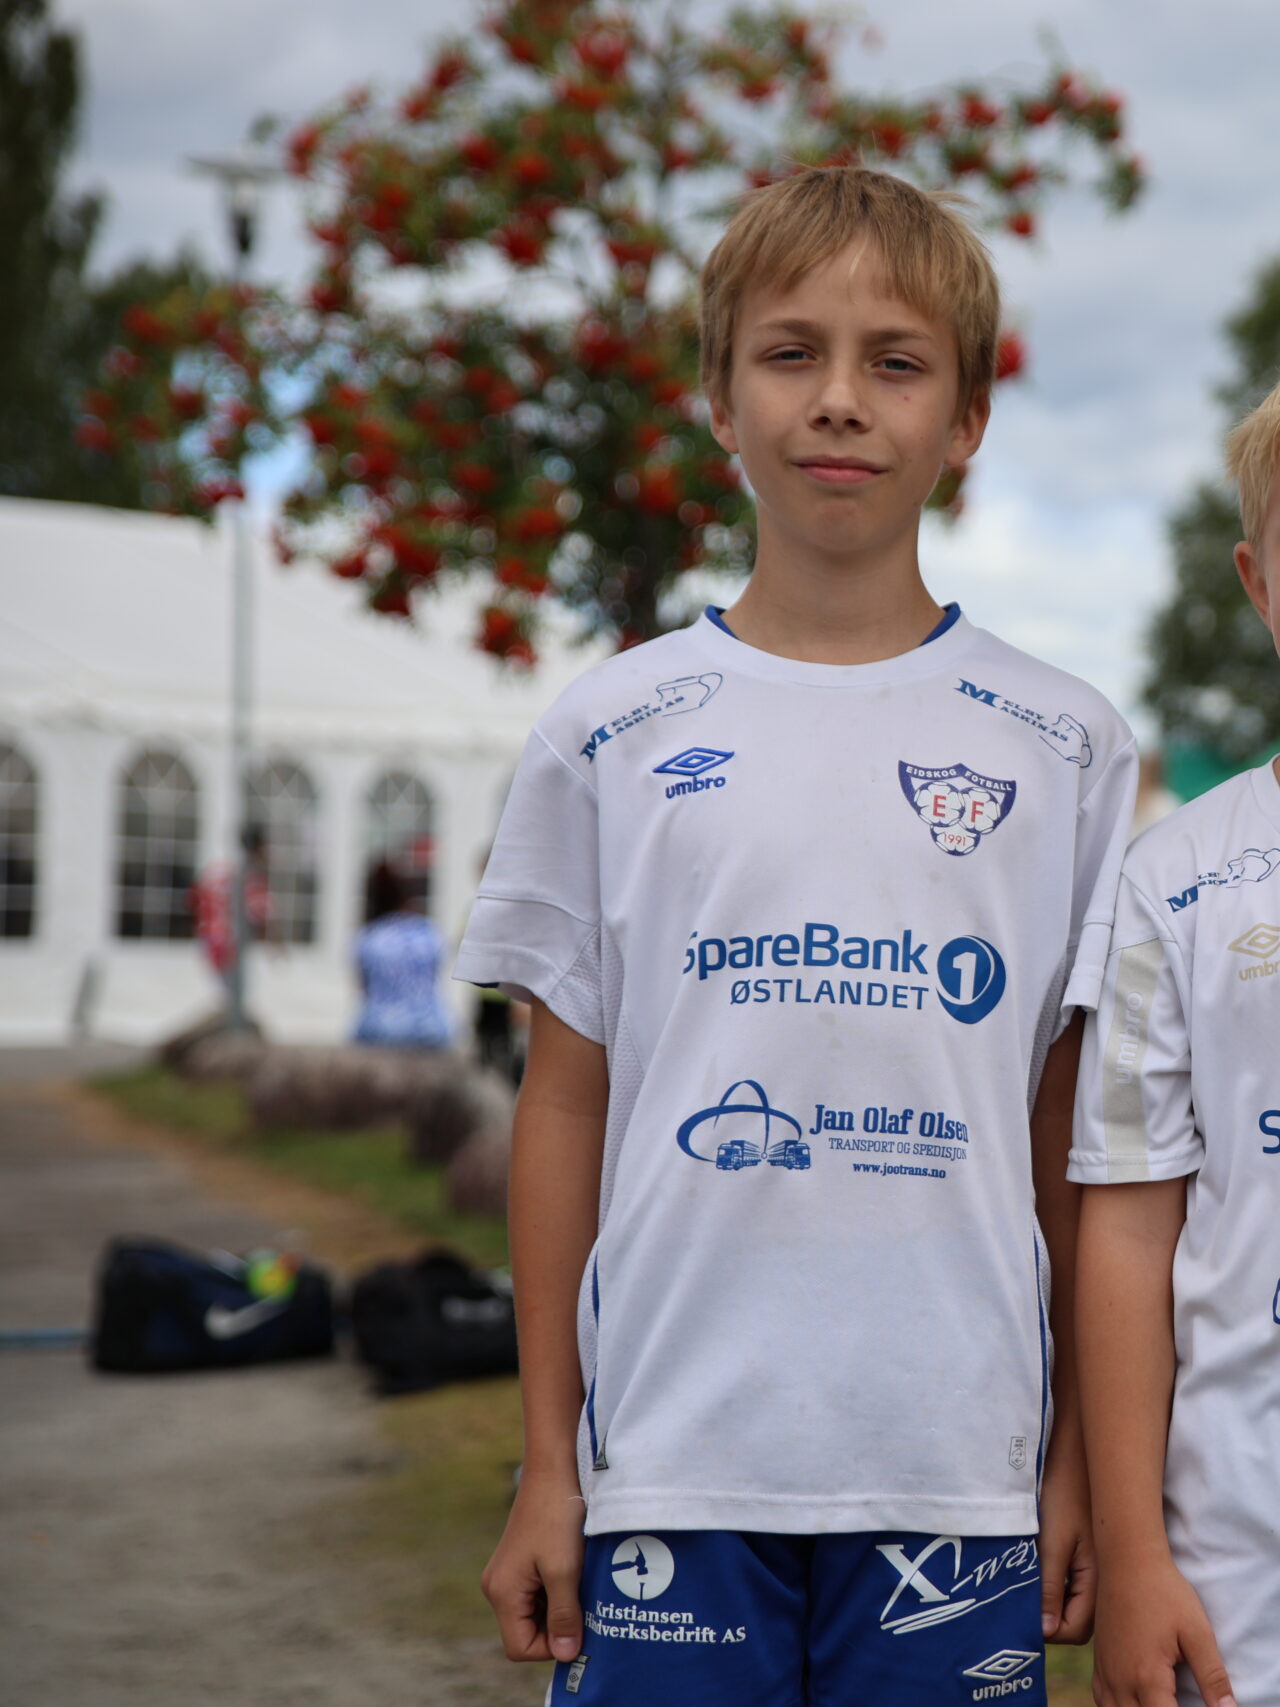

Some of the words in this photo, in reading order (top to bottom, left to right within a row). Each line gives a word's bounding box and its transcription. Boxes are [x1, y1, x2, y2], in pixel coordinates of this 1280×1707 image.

[1049, 729, 1068, 742] AS
[665, 775, 726, 799] umbro
[905, 765, 957, 779] EIDSKOG
[964, 770, 1012, 791] FOTBALL
[932, 795, 947, 818] E
[970, 801, 985, 823] F
[943, 833, 966, 847] 1991
[730, 978, 930, 1011] ØSTLANDET
[1115, 992, 1144, 1085] umbro
[809, 1104, 855, 1135] Jan
[862, 1106, 914, 1135] Olaf
[919, 1111, 969, 1144] Olsen
[828, 1137, 895, 1155] TRANSPORT
[896, 1141, 911, 1155] OG
[912, 1143, 967, 1162] SPEDISJON
[852, 1162, 947, 1179] www.jootrans.no
[596, 1600, 695, 1625] Kristiansen
[721, 1626, 747, 1644] AS
[972, 1675, 1033, 1702] umbro
